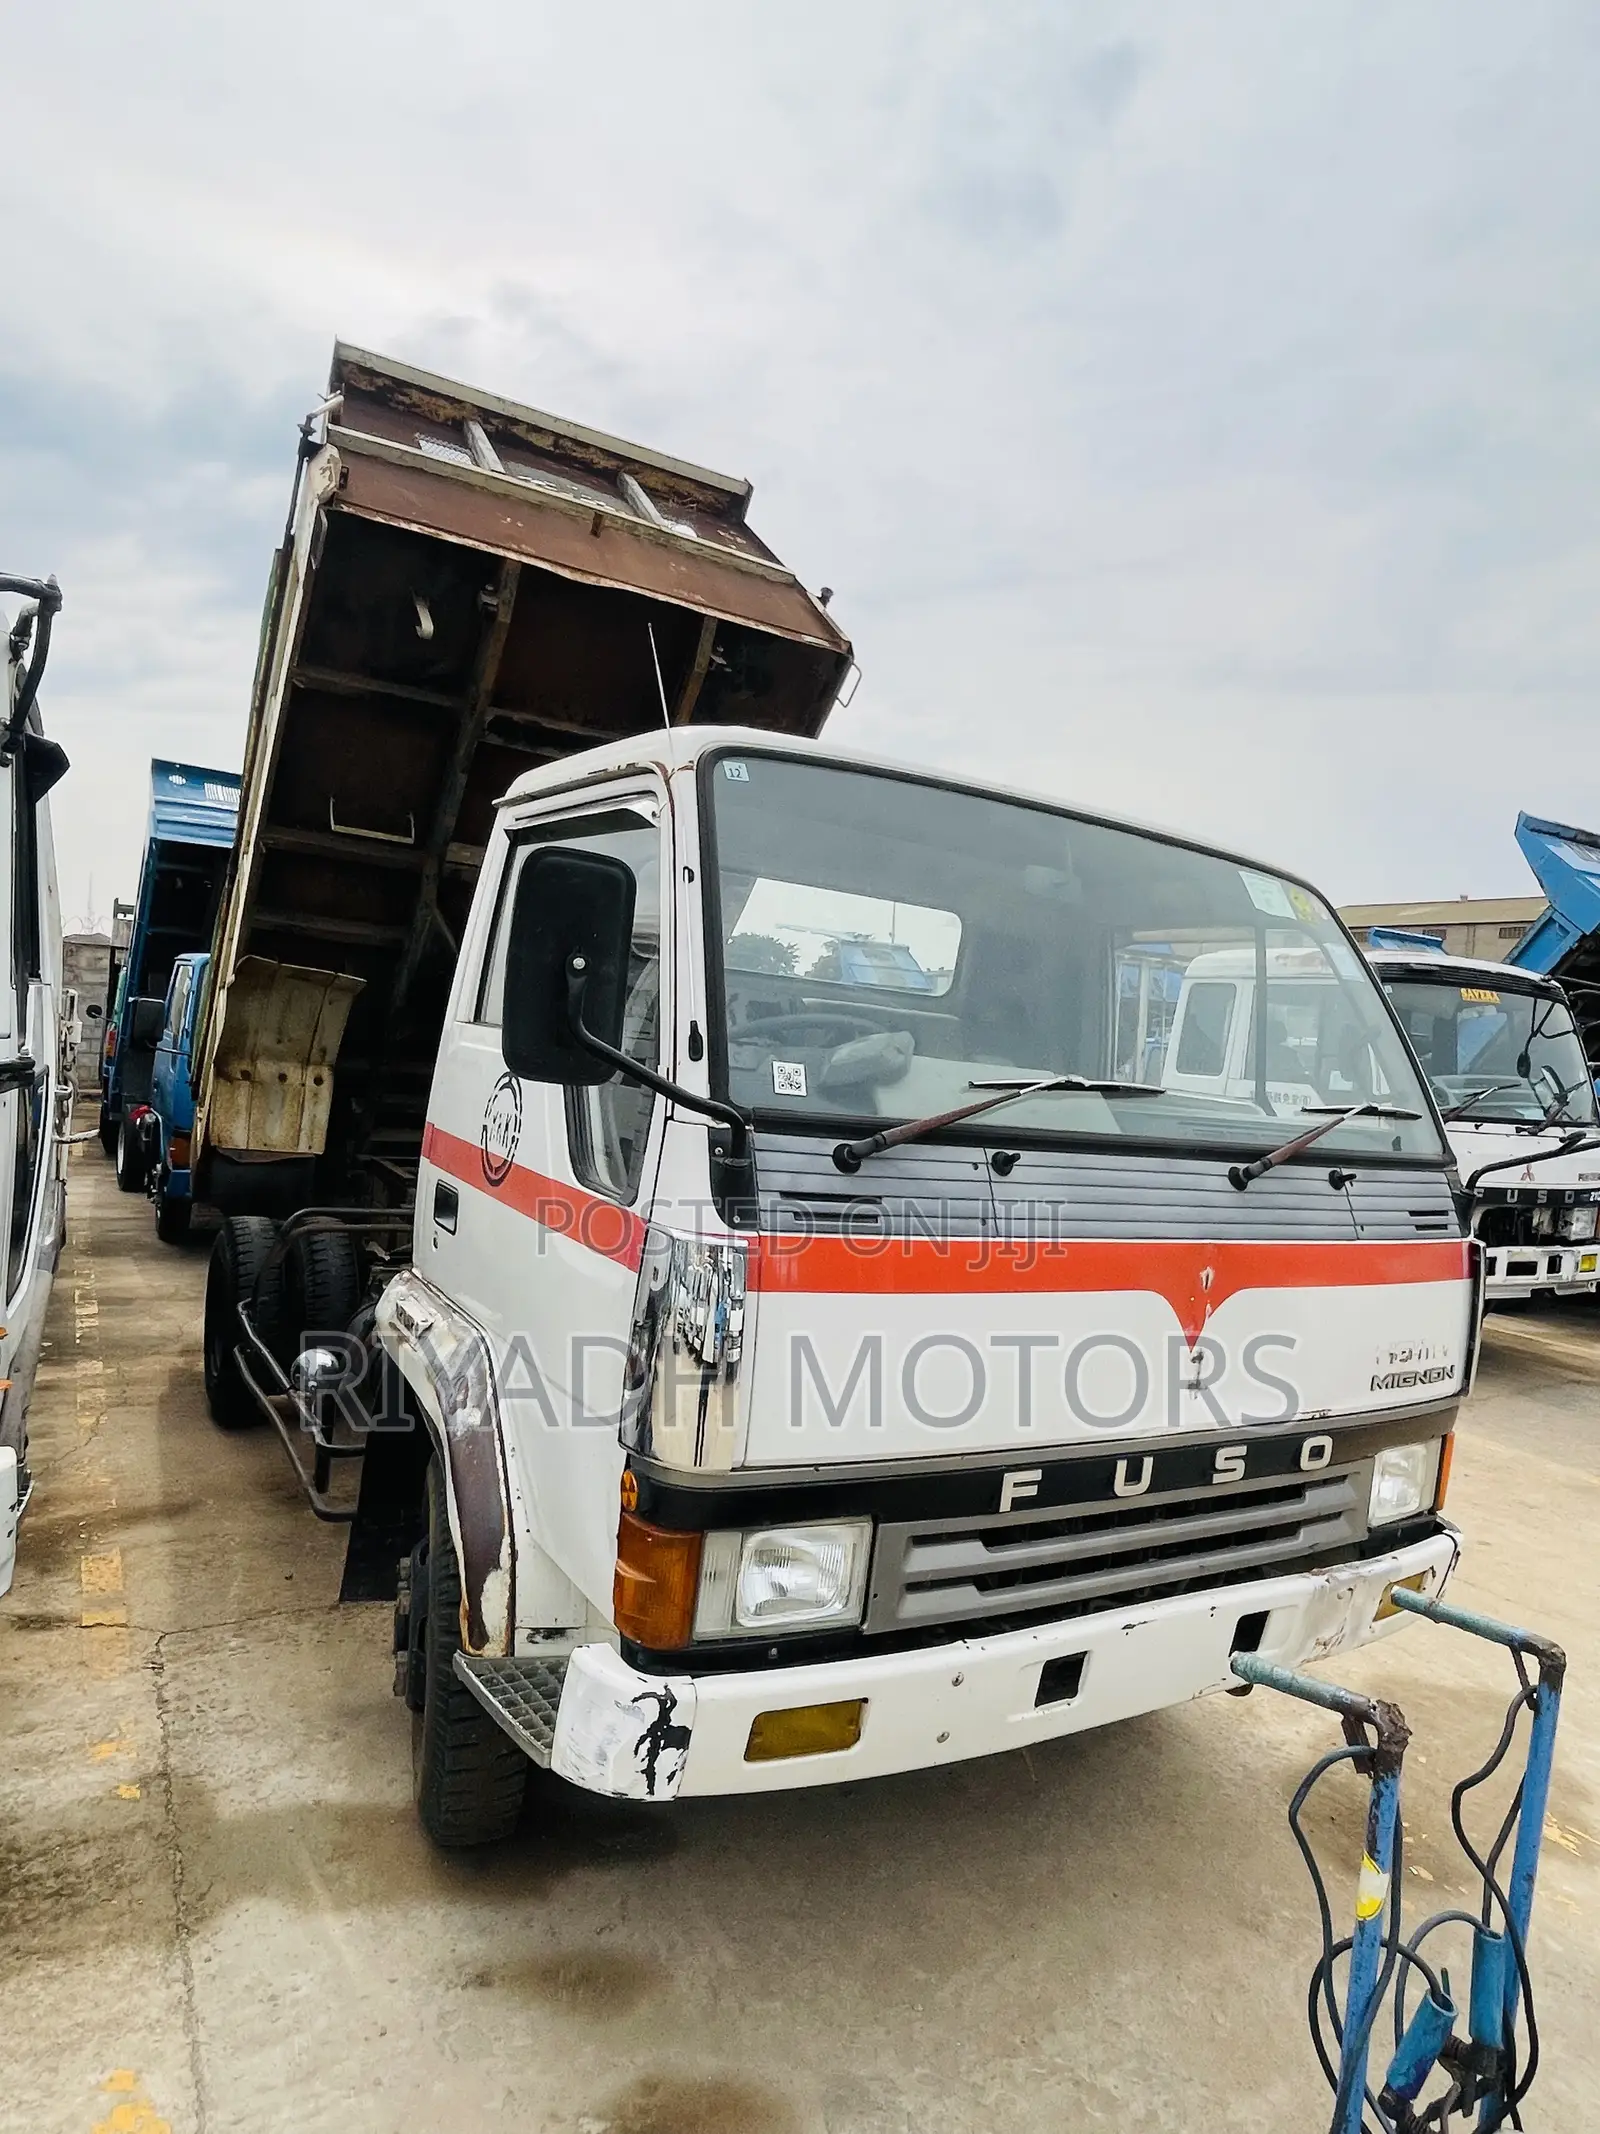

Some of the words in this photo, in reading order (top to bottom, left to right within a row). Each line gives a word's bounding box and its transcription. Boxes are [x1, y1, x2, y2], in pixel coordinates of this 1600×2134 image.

[1474, 1187, 1575, 1204] FUSO
[1370, 1365, 1455, 1391] MIGNON
[999, 1435, 1334, 1513] FUSO
